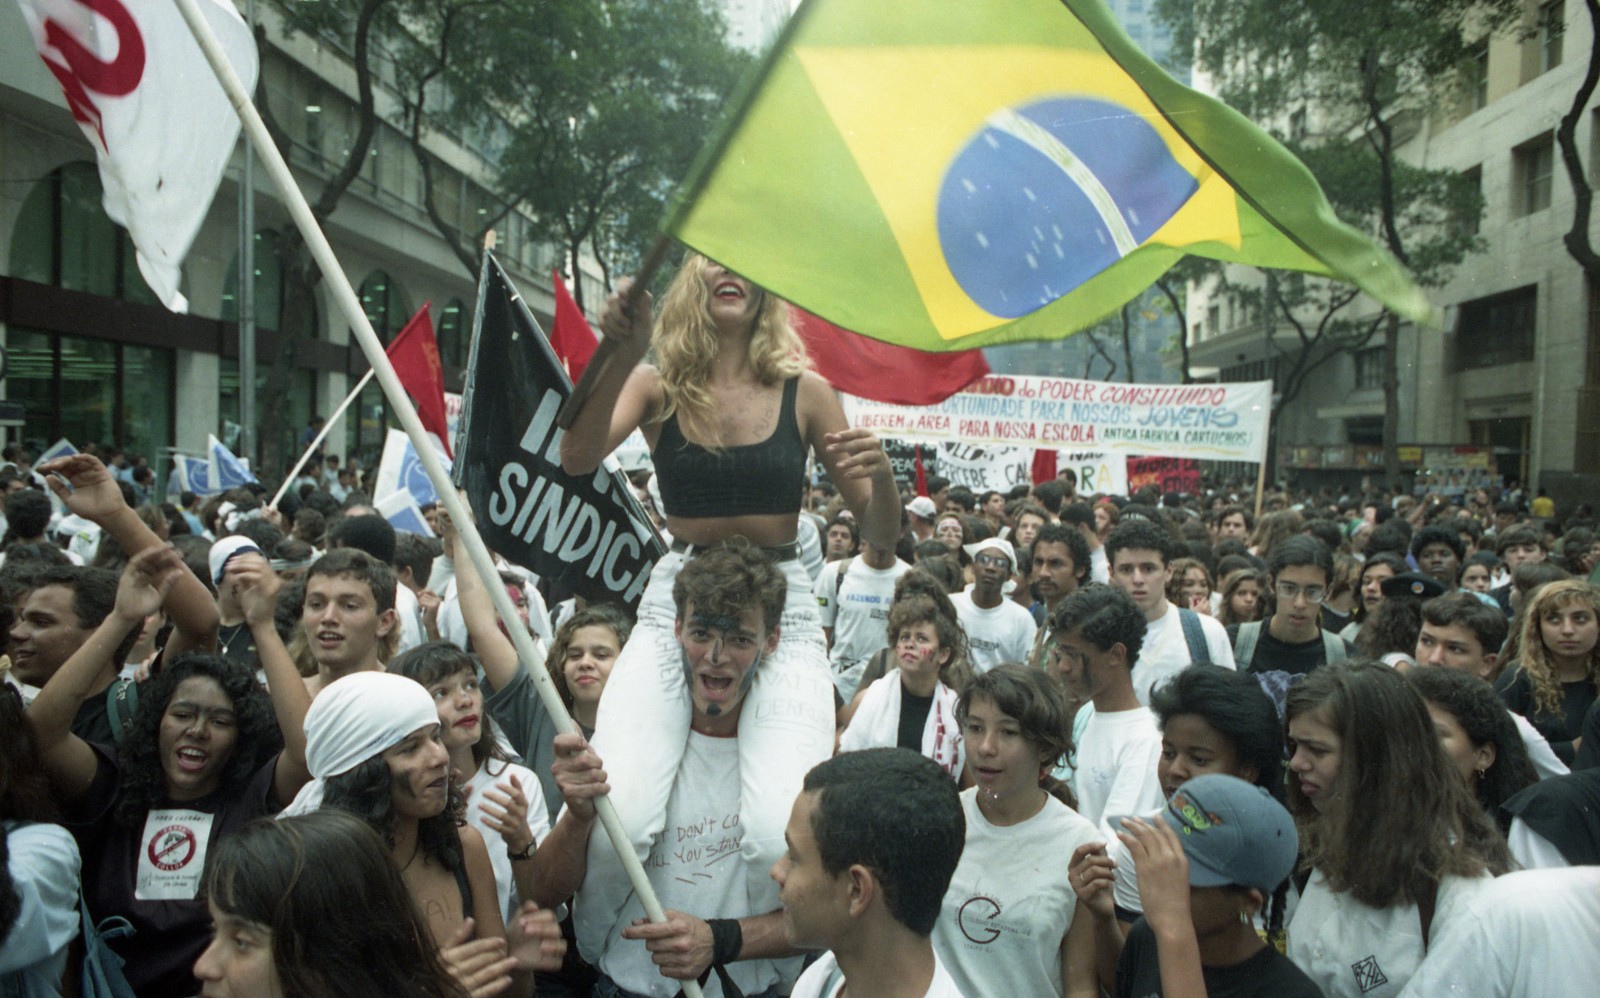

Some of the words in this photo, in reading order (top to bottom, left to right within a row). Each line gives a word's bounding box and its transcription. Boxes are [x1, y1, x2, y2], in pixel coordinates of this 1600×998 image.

[1018, 379, 1036, 399] do
[1040, 380, 1096, 401] PODER
[1100, 385, 1226, 406] CONSTITUIDO
[926, 395, 1025, 420] ORTUNIDADE
[1030, 400, 1065, 420] PARA
[1072, 402, 1132, 424] NOSSOS
[1137, 406, 1239, 428] JOVENS
[854, 413, 905, 429] LIBEREM
[916, 415, 950, 430] AREA
[959, 419, 990, 438] PARA
[993, 421, 1036, 440] NOSSA
[1042, 422, 1095, 442] ESCOLA
[489, 462, 655, 603] SINDICA
[722, 814, 740, 830] CO
[673, 845, 702, 864] YOU
[705, 836, 740, 858] STAN
